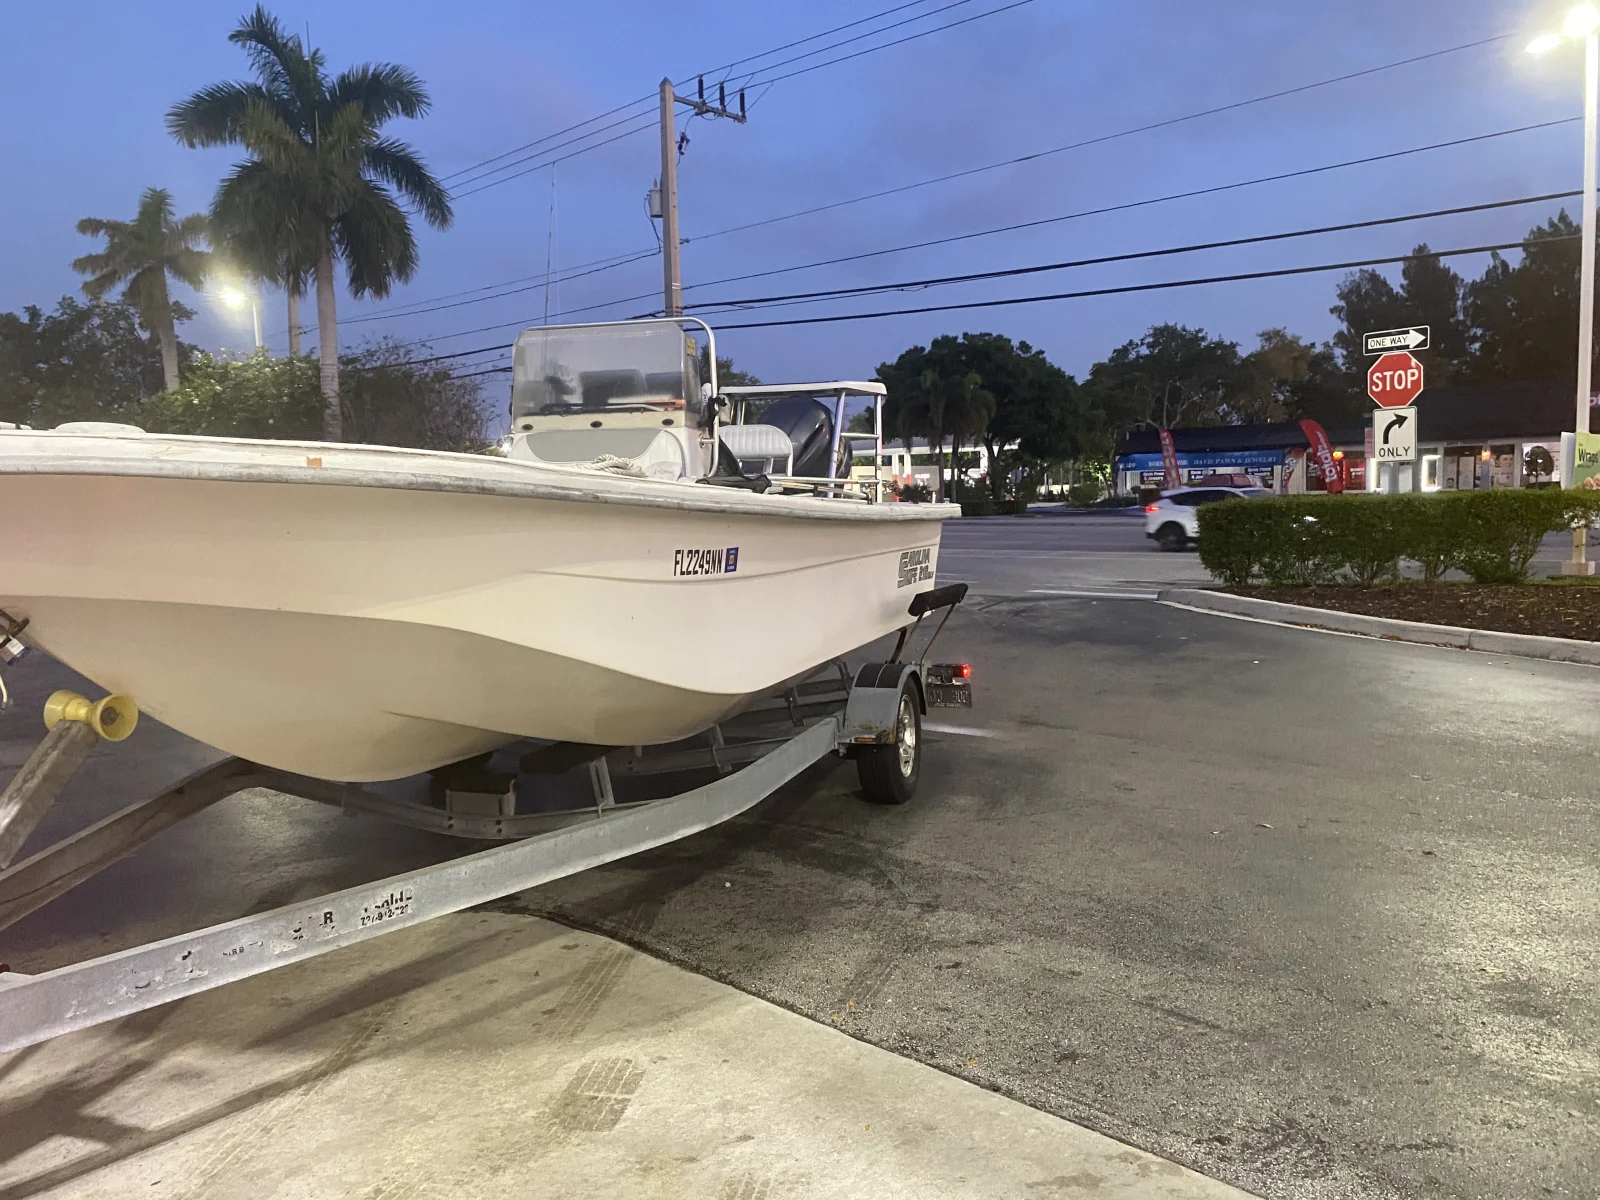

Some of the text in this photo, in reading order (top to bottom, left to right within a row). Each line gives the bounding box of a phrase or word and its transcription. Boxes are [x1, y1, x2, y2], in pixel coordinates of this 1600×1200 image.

[1369, 335, 1409, 348] ONE WAY
[1371, 368, 1419, 392] STOP
[1378, 446, 1411, 458] ONLY
[1578, 448, 1599, 466] Wraps
